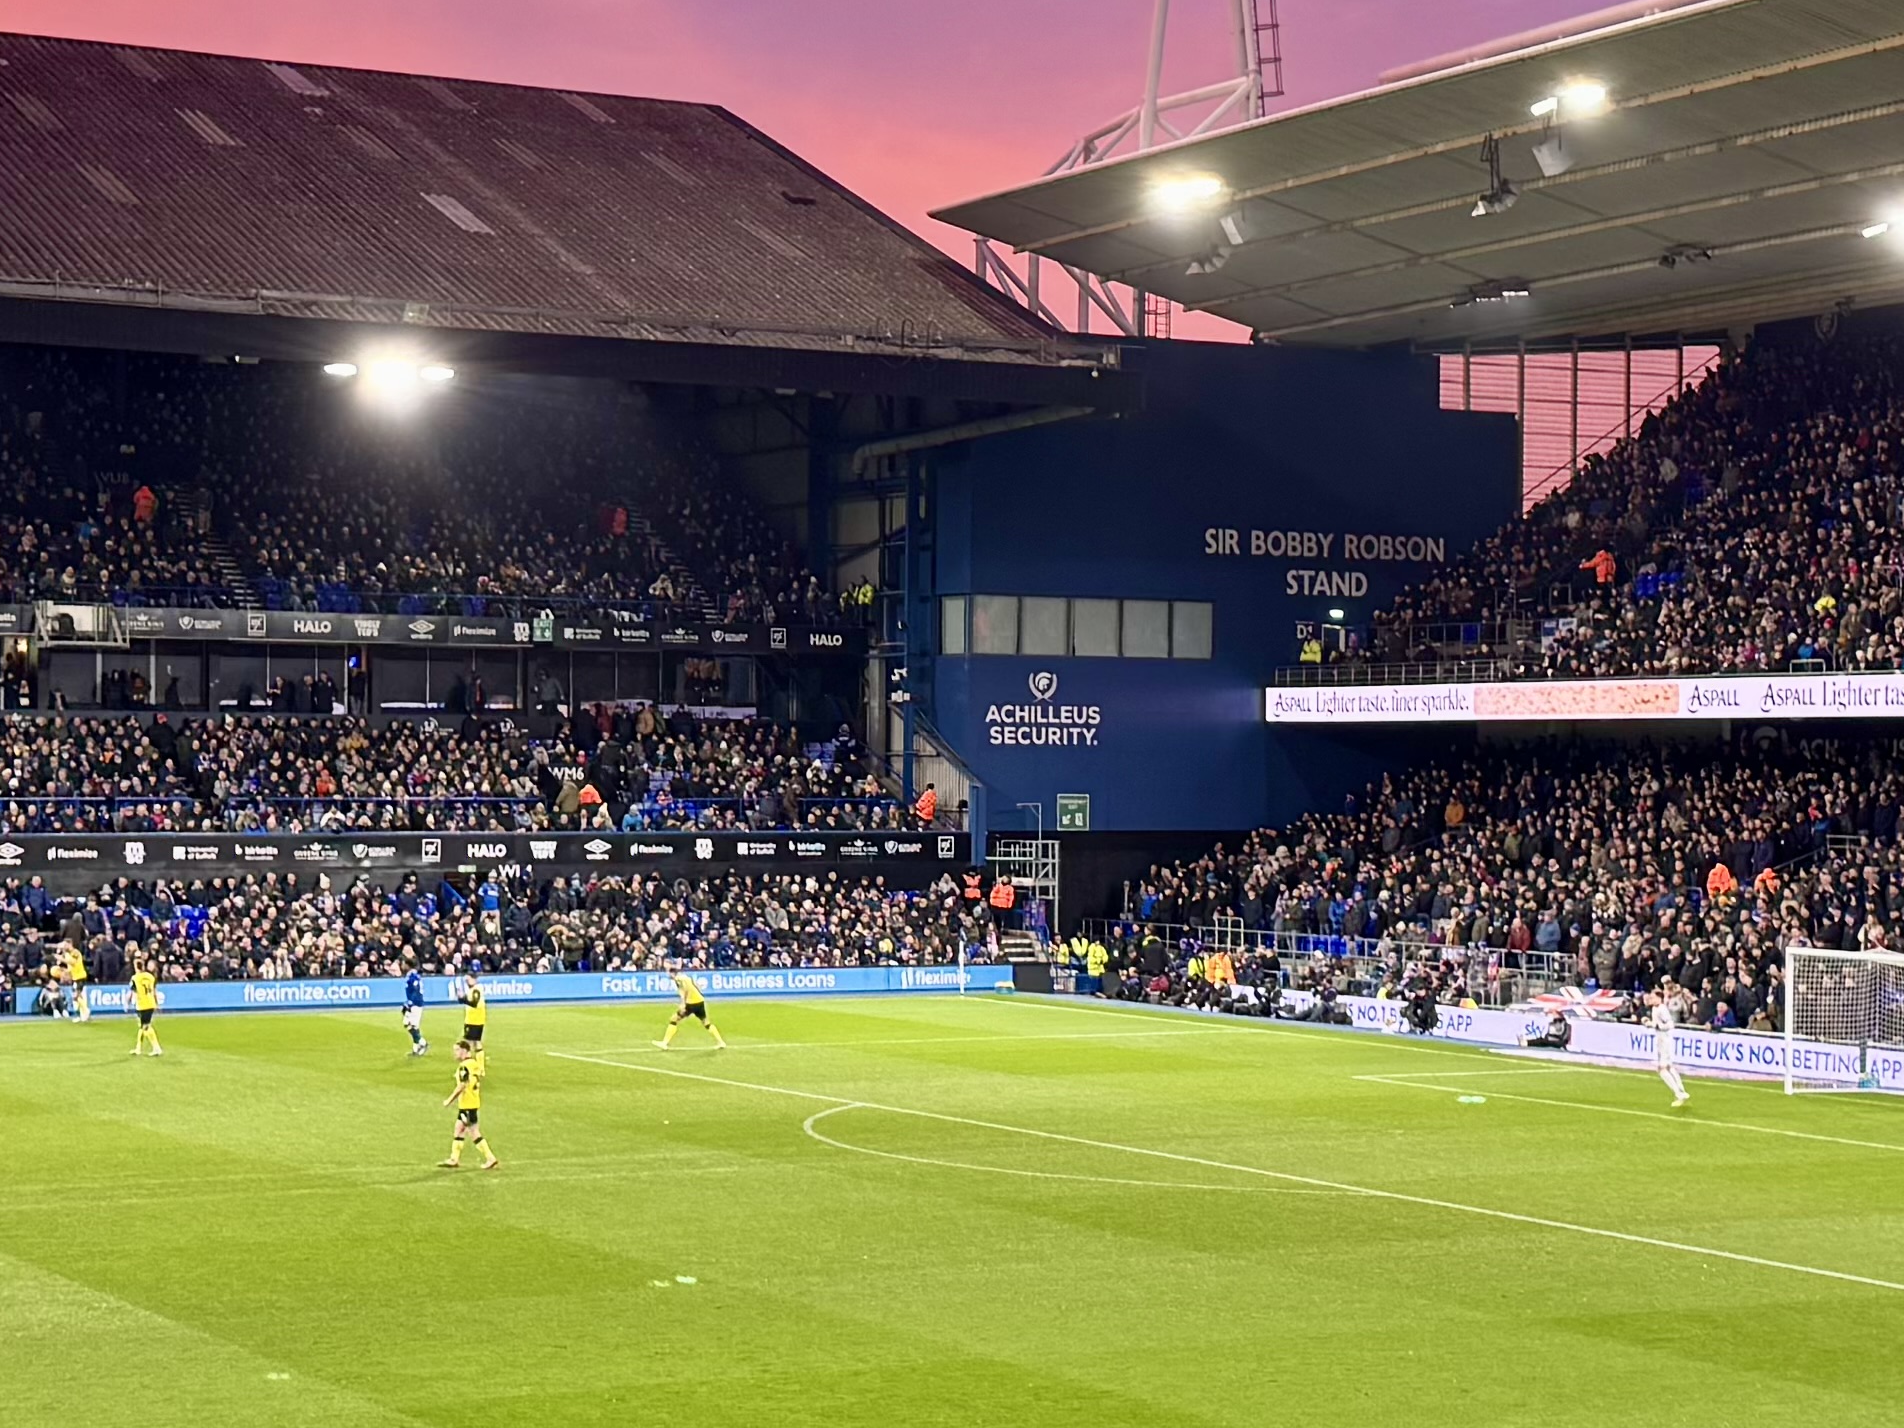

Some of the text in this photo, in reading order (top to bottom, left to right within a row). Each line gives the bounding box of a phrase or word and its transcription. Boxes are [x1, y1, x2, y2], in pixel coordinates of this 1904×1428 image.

[1205, 529, 1445, 562] SIR BOBBY ROBSON
[1286, 570, 1368, 597] STAND
[294, 619, 332, 635] HALO
[810, 633, 843, 646] HALO
[1273, 692, 1312, 718] ASPALL
[1316, 691, 1357, 717] Lighter
[1391, 688, 1419, 712] finer
[1421, 688, 1470, 715] sparkle.
[1687, 683, 1741, 714] ASPALL
[1760, 683, 1816, 713] ASPALL
[1823, 680, 1881, 712] Lighter
[985, 704, 1101, 725] ACHILLEUS
[548, 766, 585, 780] WM6
[468, 843, 507, 859] HALO
[602, 976, 642, 995] Fast,
[712, 973, 784, 990] Business
[788, 971, 836, 988] Loans
[244, 984, 371, 1006] fleximize.com
[1446, 1012, 1472, 1033] APP
[1672, 1037, 1702, 1056] THE
[1707, 1039, 1744, 1061] UK'S
[1792, 1052, 1860, 1075] BETTING
[1870, 1059, 1902, 1080] APP
